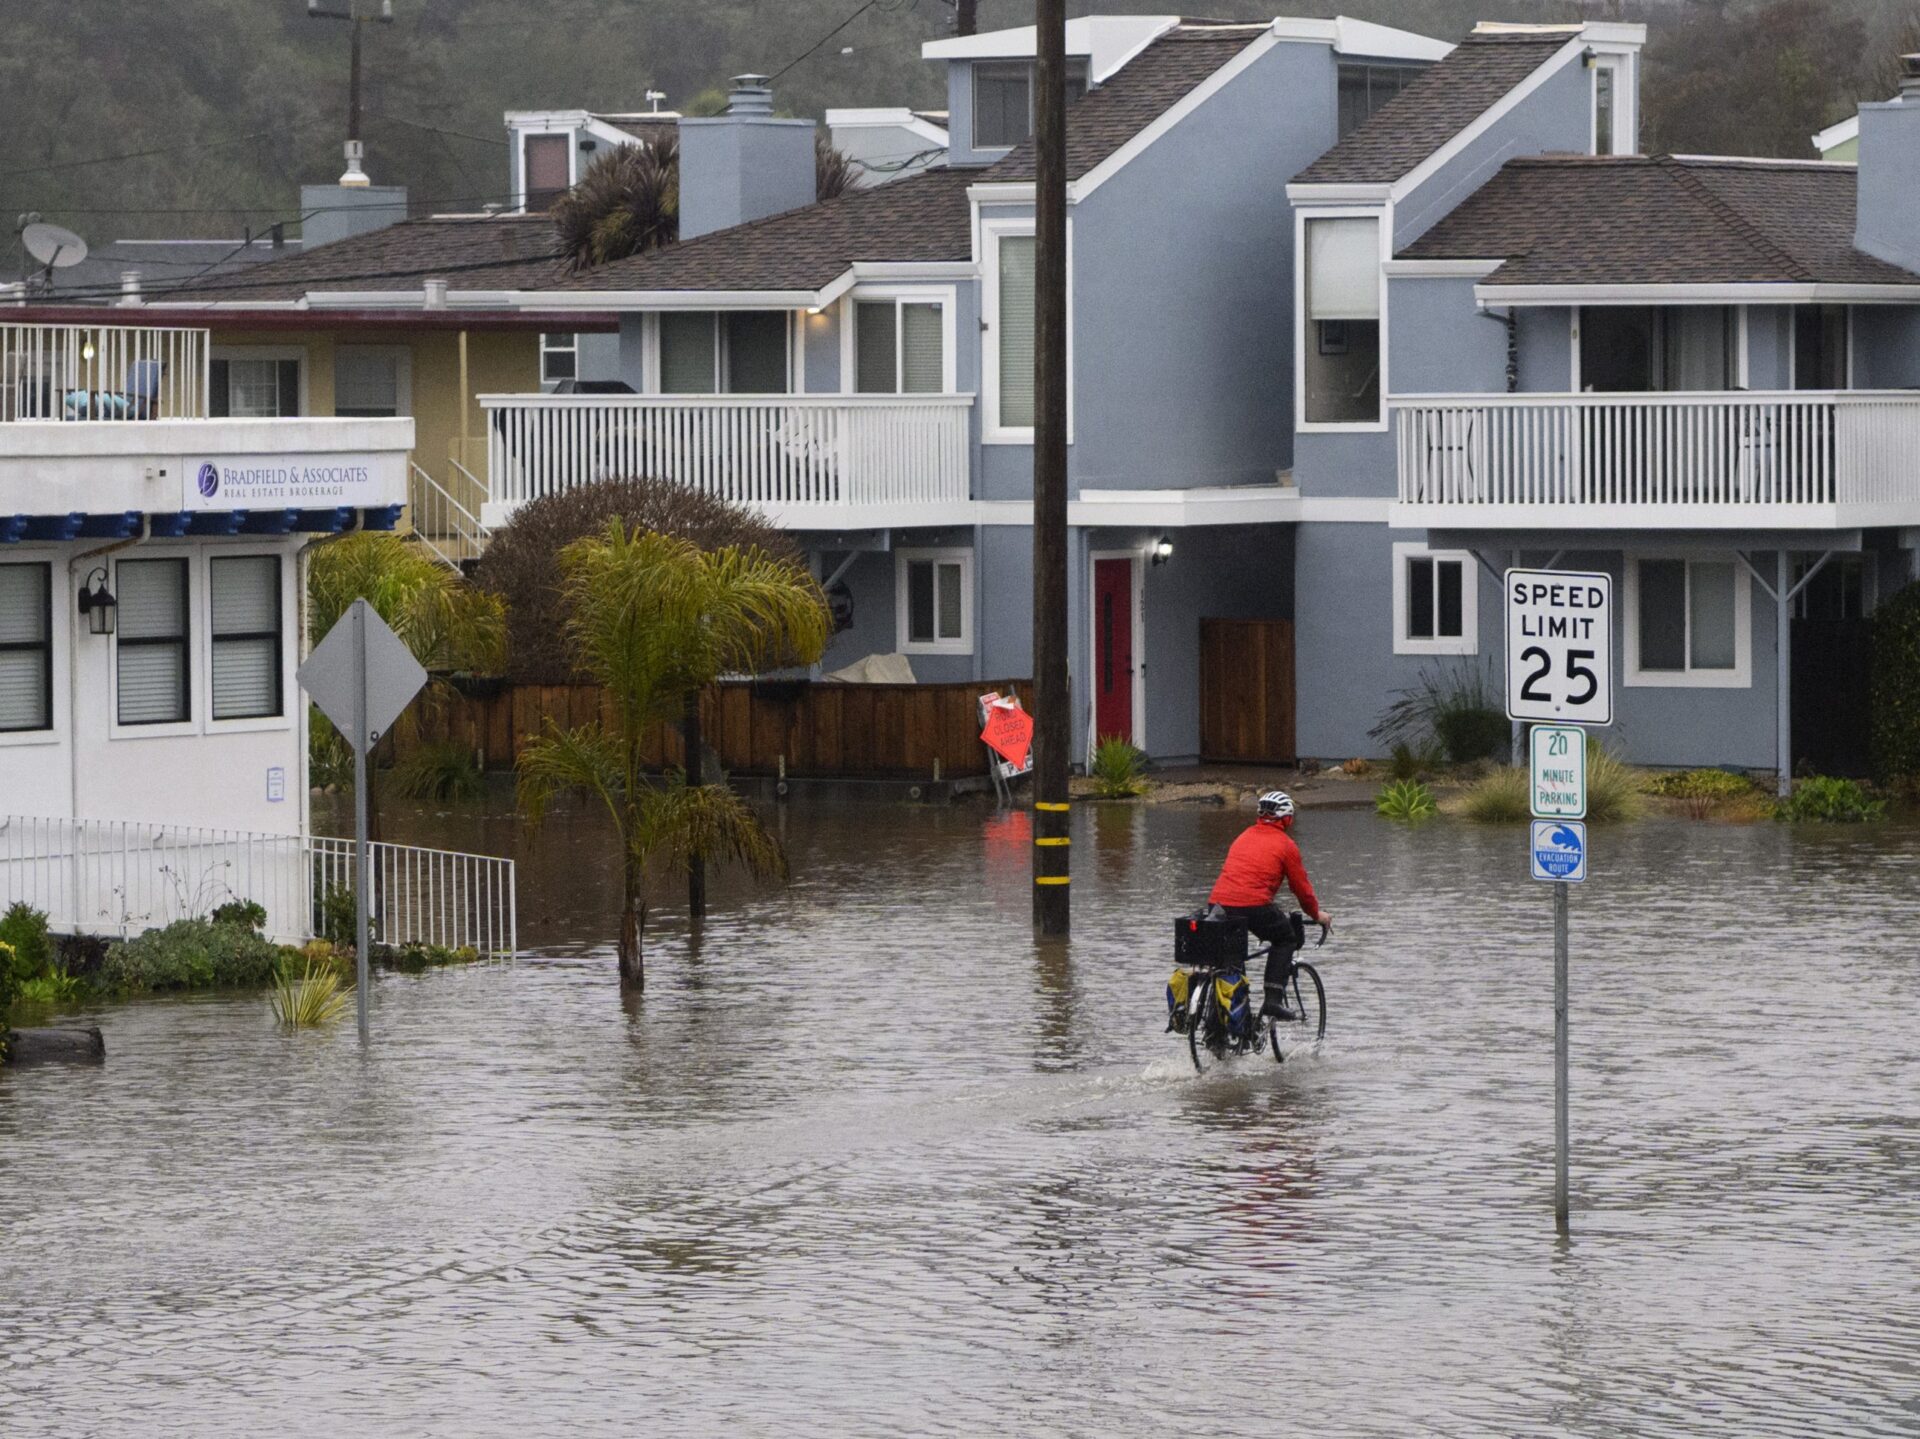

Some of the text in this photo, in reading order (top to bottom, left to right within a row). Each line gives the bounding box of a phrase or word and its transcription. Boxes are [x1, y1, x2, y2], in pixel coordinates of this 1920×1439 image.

[223, 466, 368, 485] BRADFIELD & ASSOCIATES
[224, 486, 344, 498] REAL ESTATE BROKERAGE
[1513, 582, 1604, 609] SPEED
[1522, 614, 1594, 639] LIMIT
[1520, 646, 1598, 705] 25
[993, 720, 1025, 736] CLOSED
[1000, 733, 1027, 746] AHEAD
[1548, 735, 1568, 756] 20
[1542, 768, 1574, 783] MINUTE
[1540, 791, 1578, 806] PARKING
[1539, 852, 1579, 864] EVACUATION
[1548, 863, 1569, 874] ROUTE
